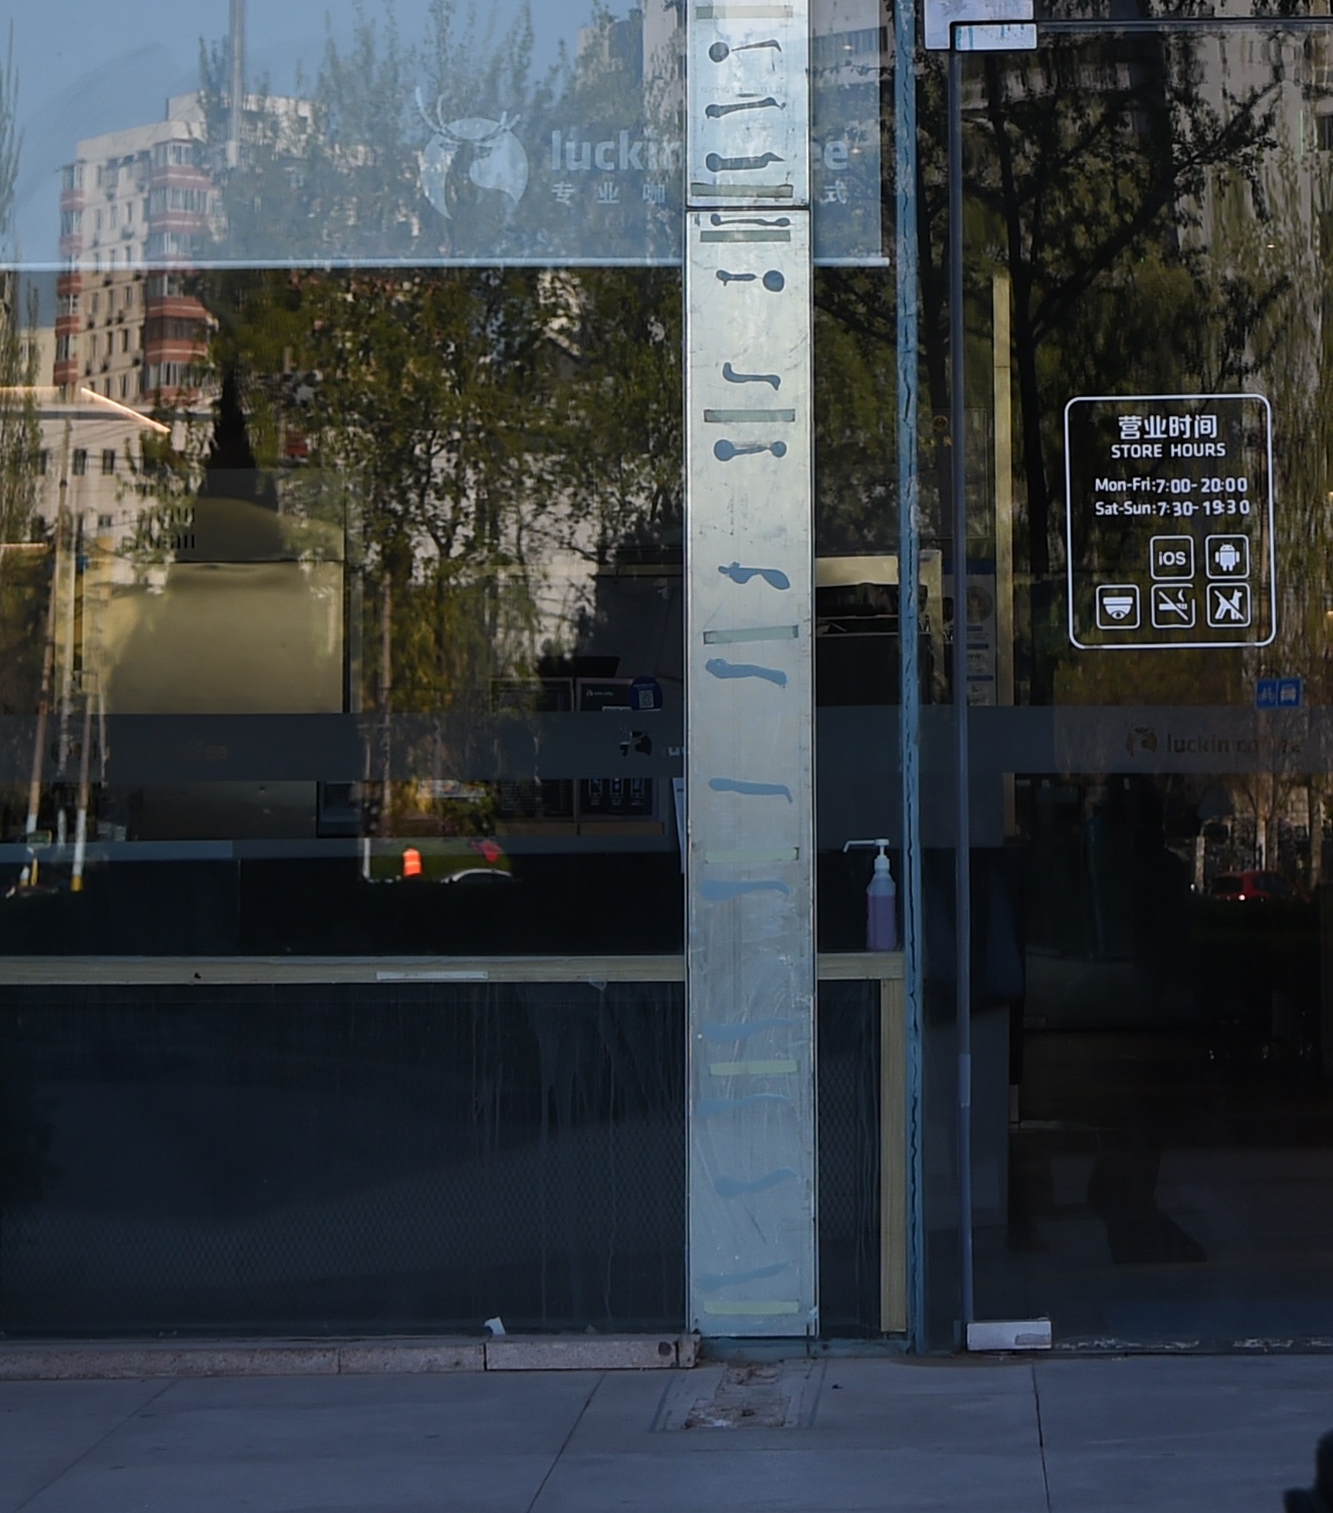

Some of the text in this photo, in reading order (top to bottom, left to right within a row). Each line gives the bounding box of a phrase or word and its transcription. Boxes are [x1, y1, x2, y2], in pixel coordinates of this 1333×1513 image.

[1117, 414, 1218, 440] 营业时间
[1110, 442, 1227, 459] STORE HOURS
[1157, 550, 1187, 566] iOS
[1166, 733, 1230, 753] luckin
